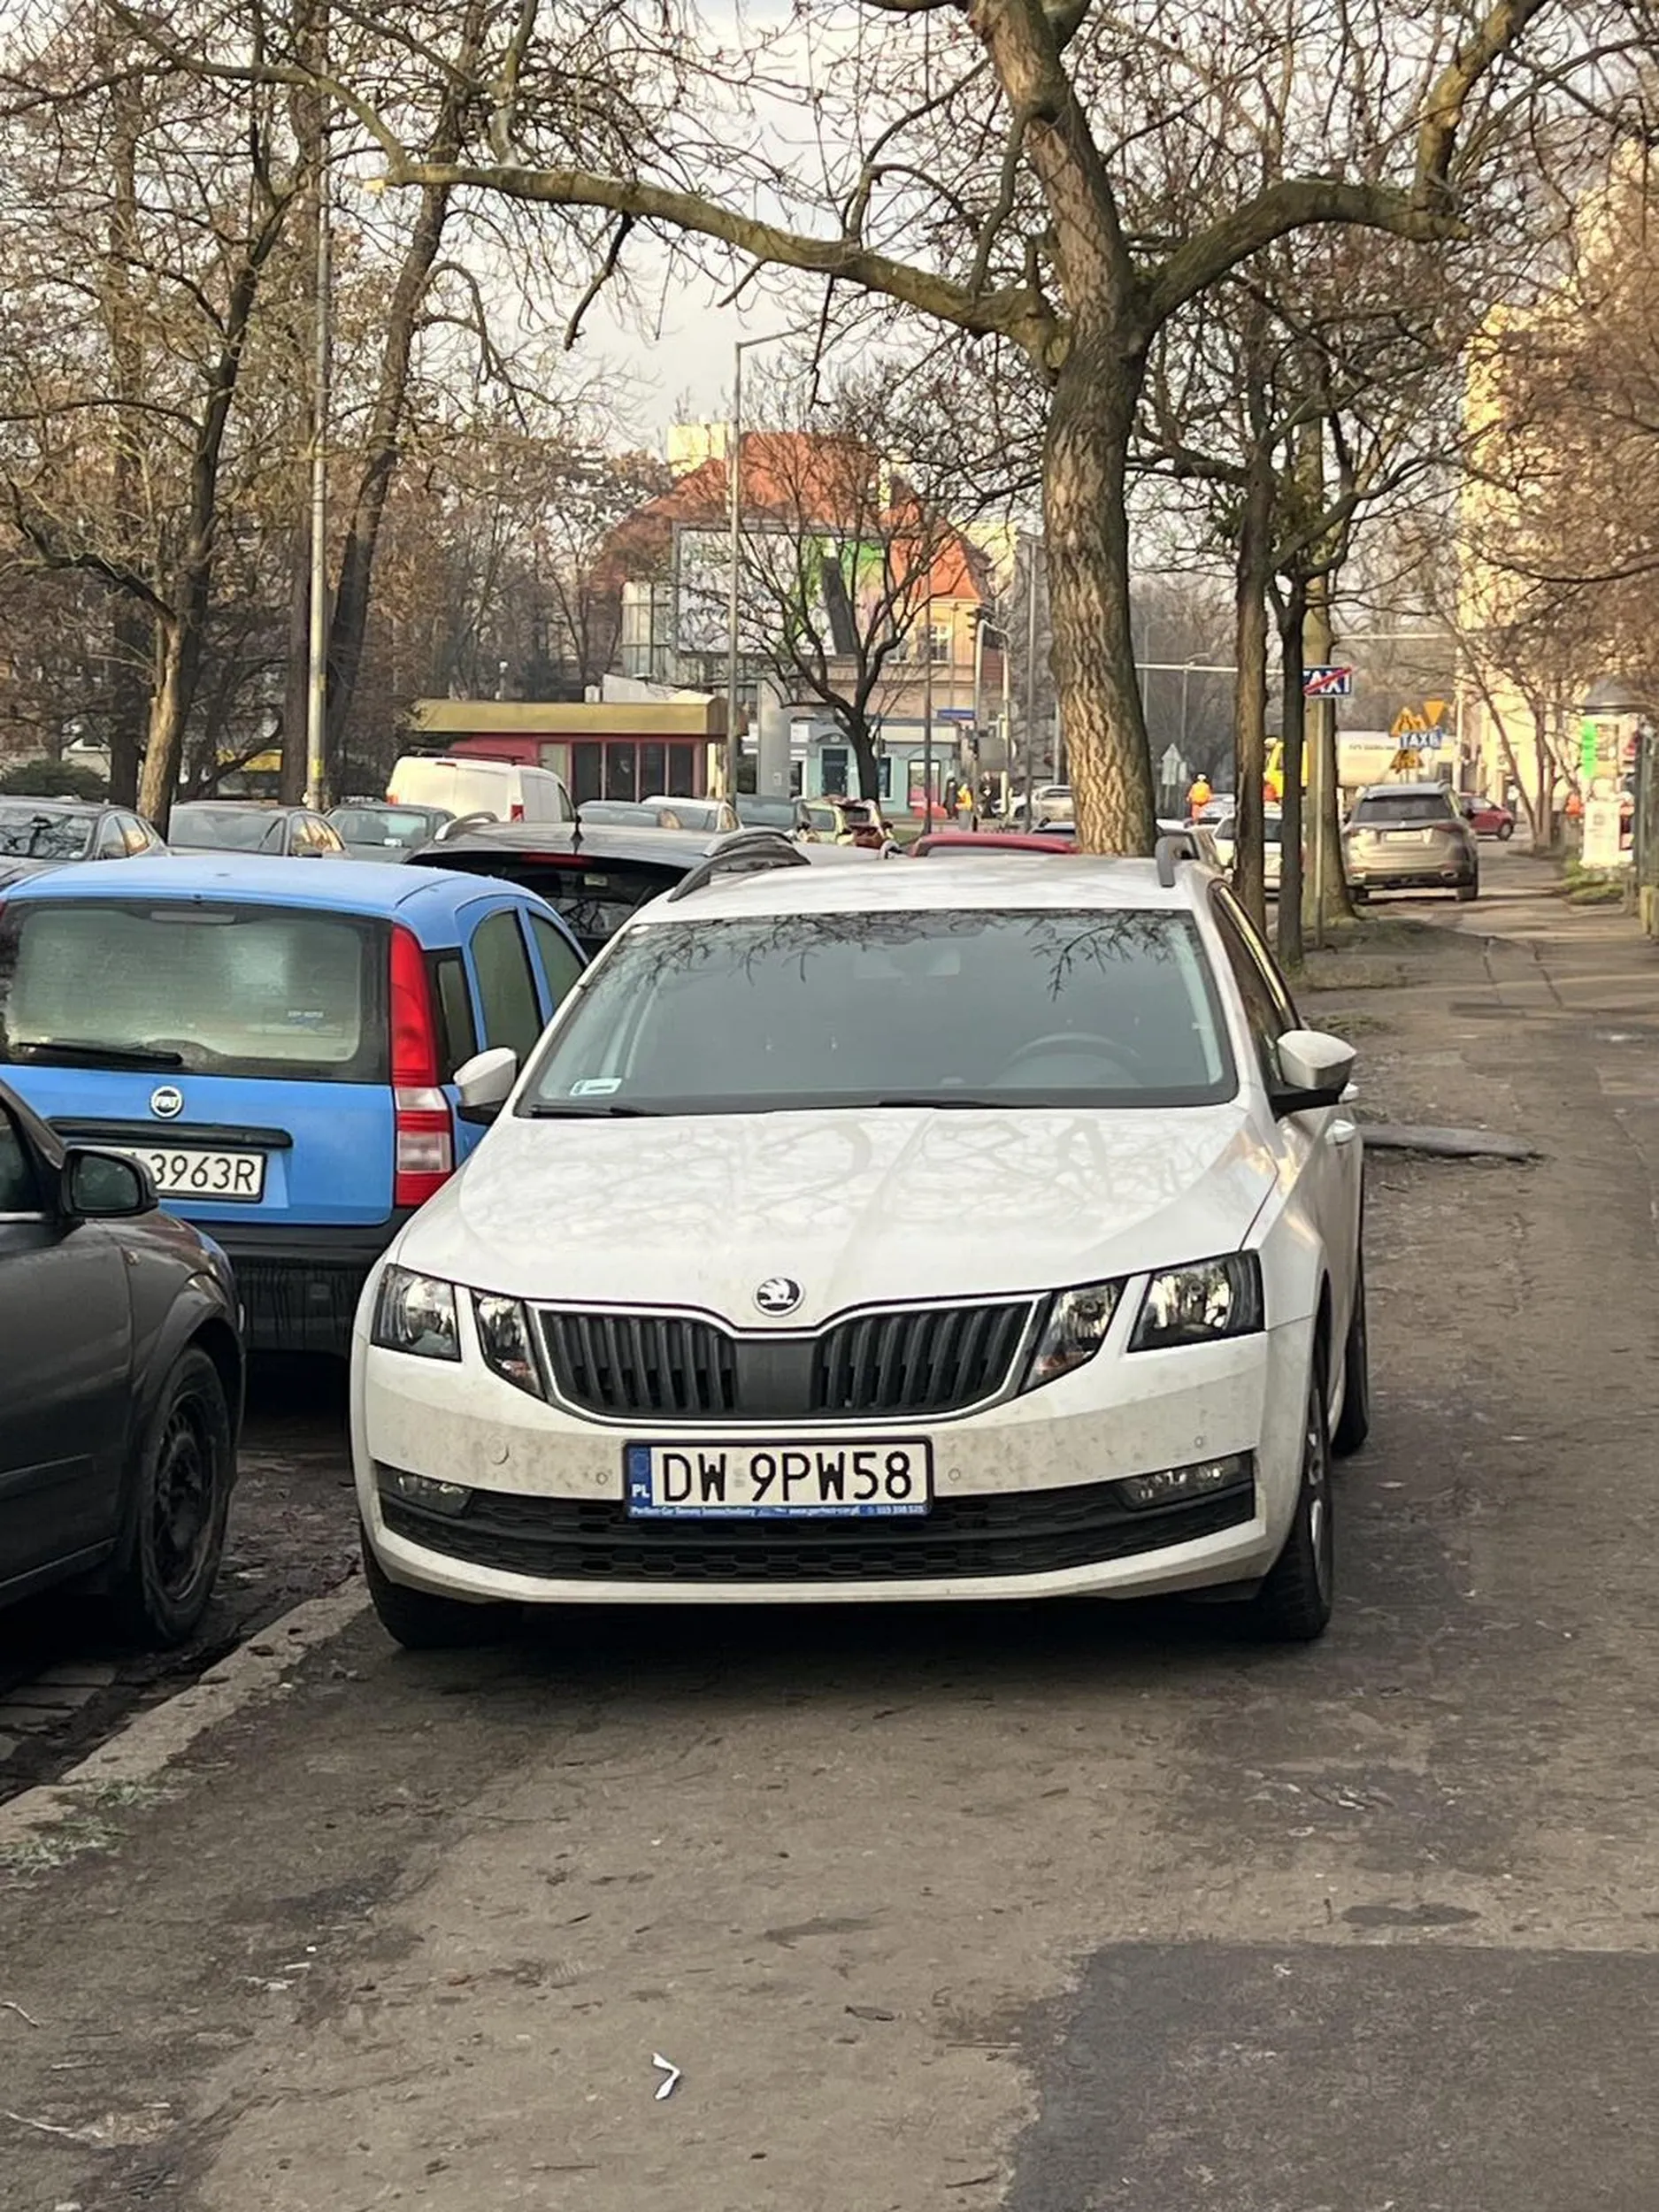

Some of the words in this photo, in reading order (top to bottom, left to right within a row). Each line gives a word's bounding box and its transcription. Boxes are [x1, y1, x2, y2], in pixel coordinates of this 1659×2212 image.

[632, 1484, 650, 1498] PL
[663, 1453, 726, 1502] DW
[750, 1450, 912, 1502] 9PW58
